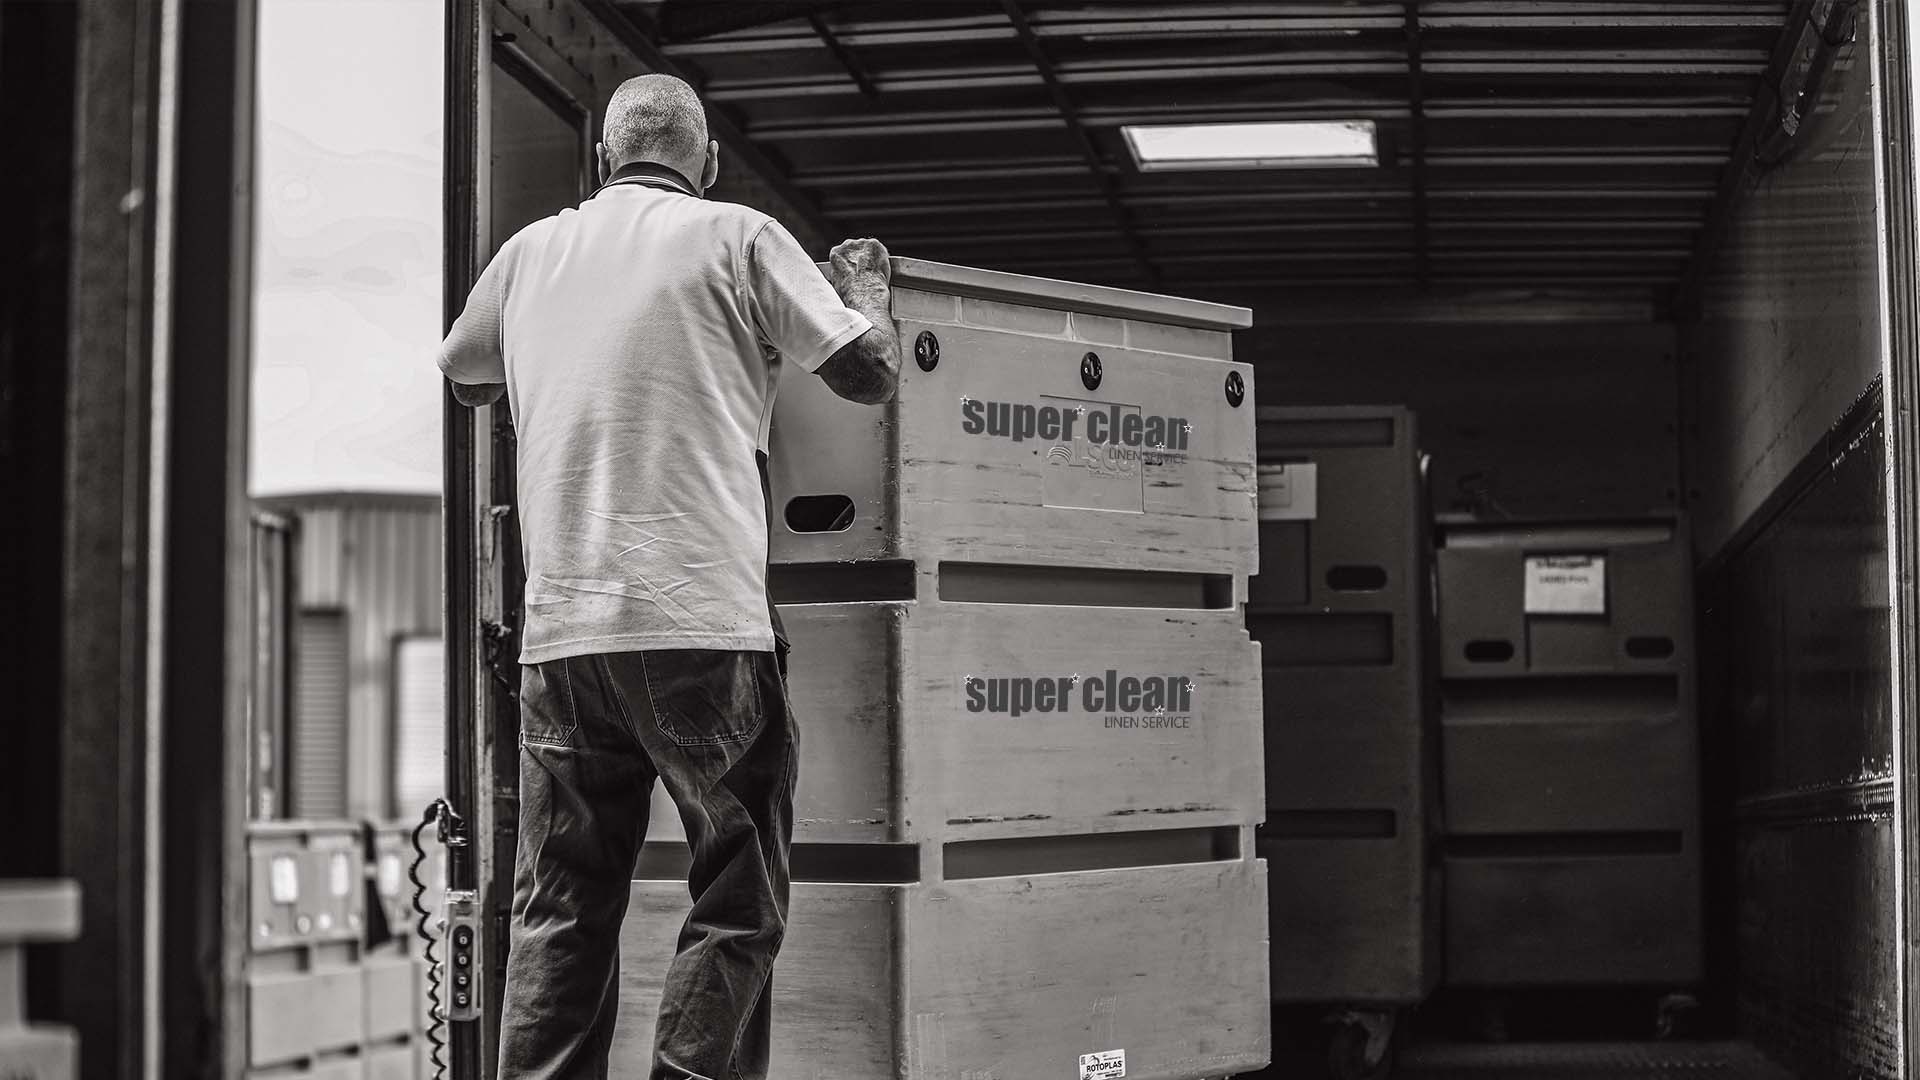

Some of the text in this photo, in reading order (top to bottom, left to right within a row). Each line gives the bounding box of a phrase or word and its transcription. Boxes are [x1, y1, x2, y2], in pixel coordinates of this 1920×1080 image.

[962, 399, 1188, 450] super clean
[1108, 447, 1188, 465] LINEN SERVICE
[966, 670, 1191, 717] super clean
[1104, 716, 1190, 729] LINEN SERVICE
[1086, 1060, 1123, 1073] ROTOPLAS
